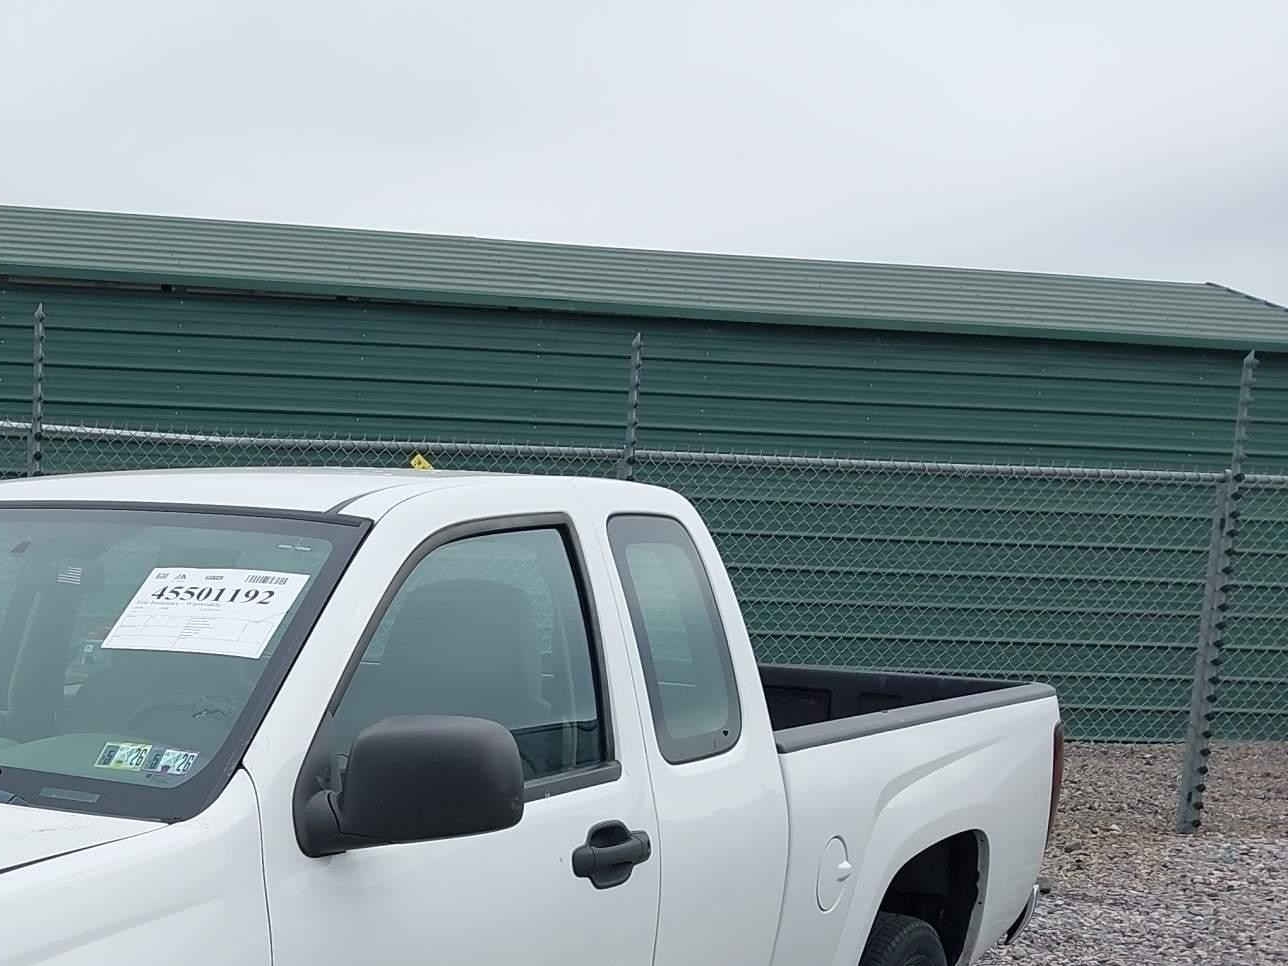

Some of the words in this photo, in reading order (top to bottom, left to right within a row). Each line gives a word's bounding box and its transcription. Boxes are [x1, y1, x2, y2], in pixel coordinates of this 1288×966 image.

[152, 585, 275, 605] 45501192
[129, 748, 147, 766] 26
[175, 753, 195, 772] 26
